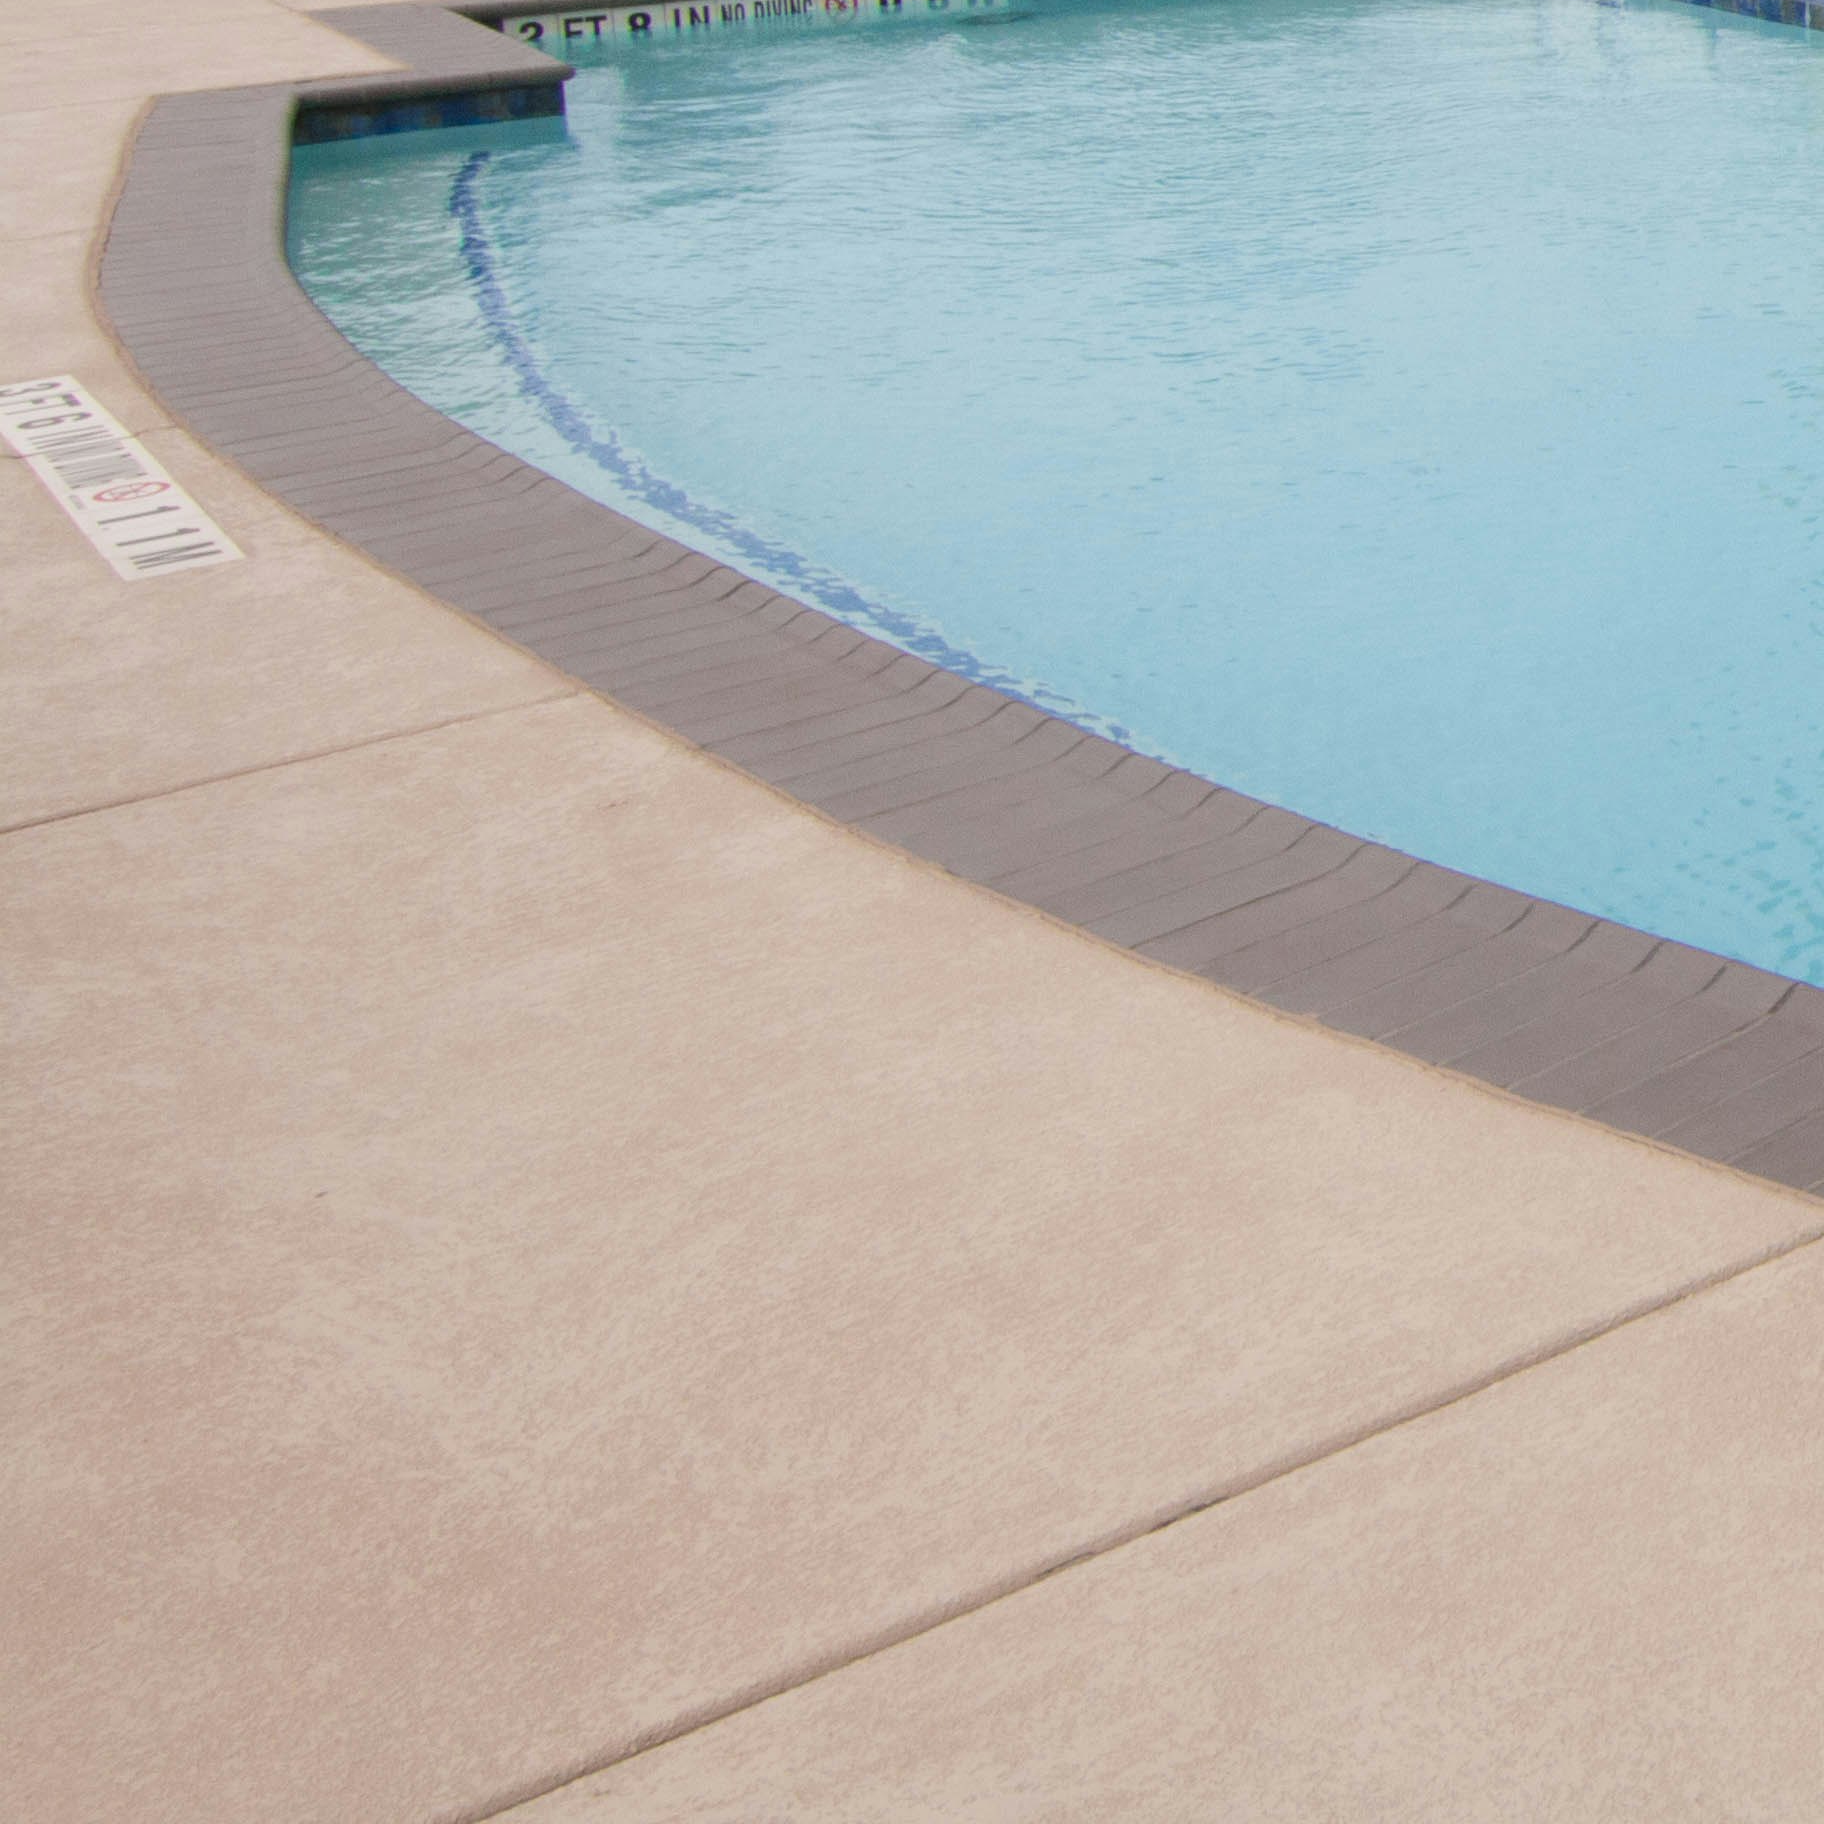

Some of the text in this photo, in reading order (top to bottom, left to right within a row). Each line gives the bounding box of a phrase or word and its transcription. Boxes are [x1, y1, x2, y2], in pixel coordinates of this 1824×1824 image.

[563, 15, 607, 39] FT
[673, 5, 710, 28] IN
[720, 2, 745, 22] NO
